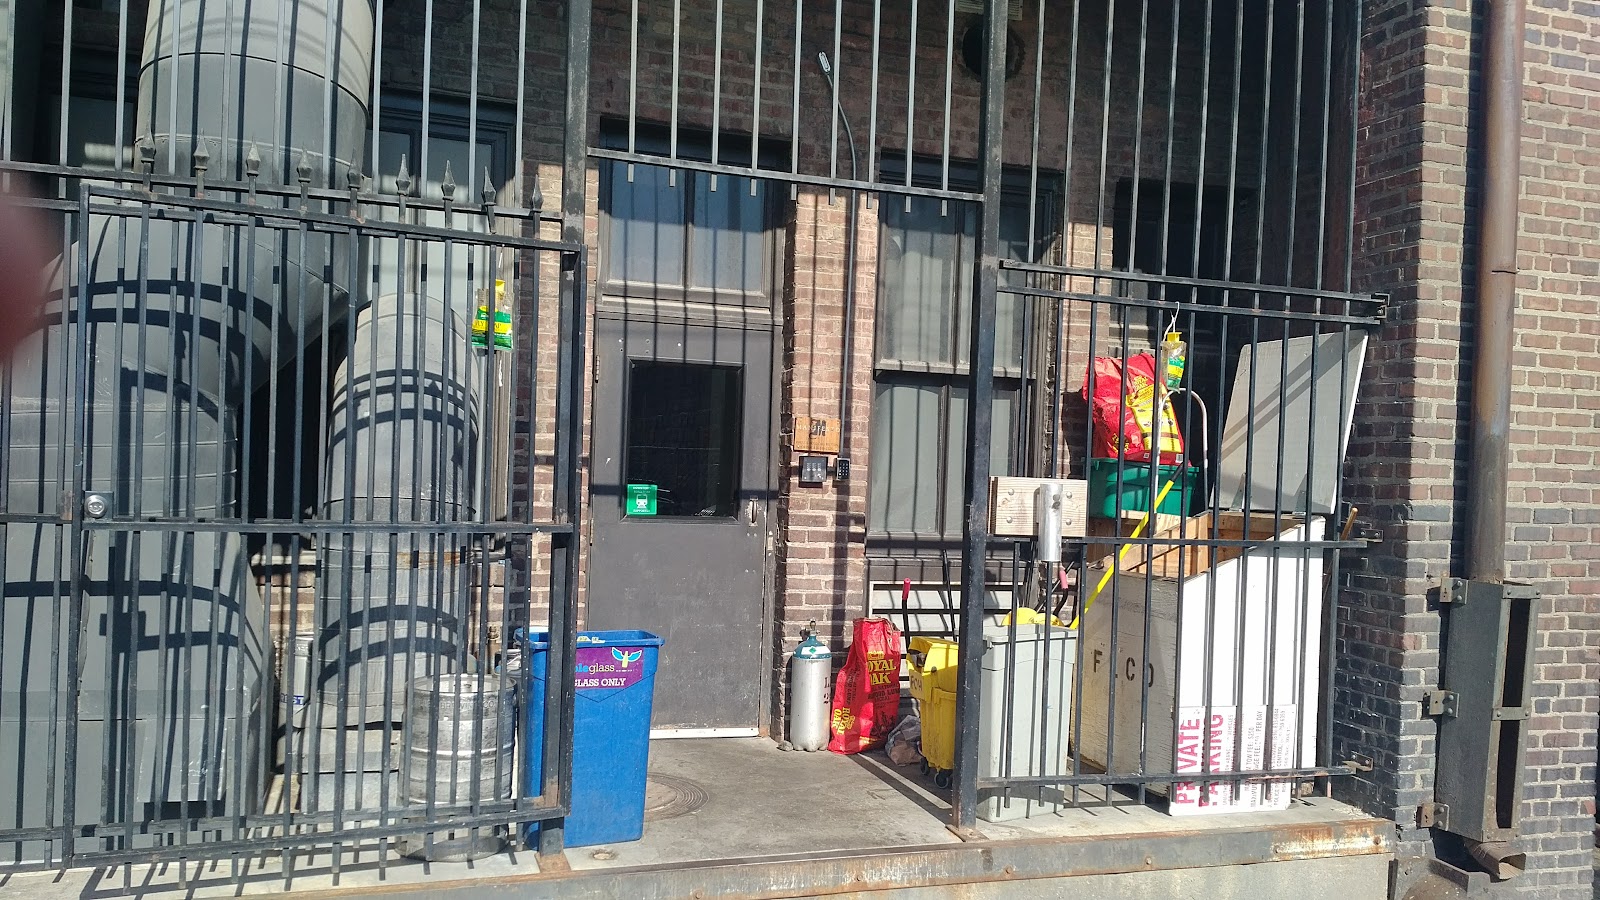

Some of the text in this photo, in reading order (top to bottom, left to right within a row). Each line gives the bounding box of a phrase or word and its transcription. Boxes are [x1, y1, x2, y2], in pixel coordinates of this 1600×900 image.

[868, 658, 897, 672] OYAL
[600, 677, 627, 687] ONLY
[870, 671, 892, 686] AK
[831, 708, 843, 730] OAK
[836, 706, 851, 735] ROYAL
[1175, 718, 1201, 805] PRVATE
[1198, 714, 1224, 808] PAKING
